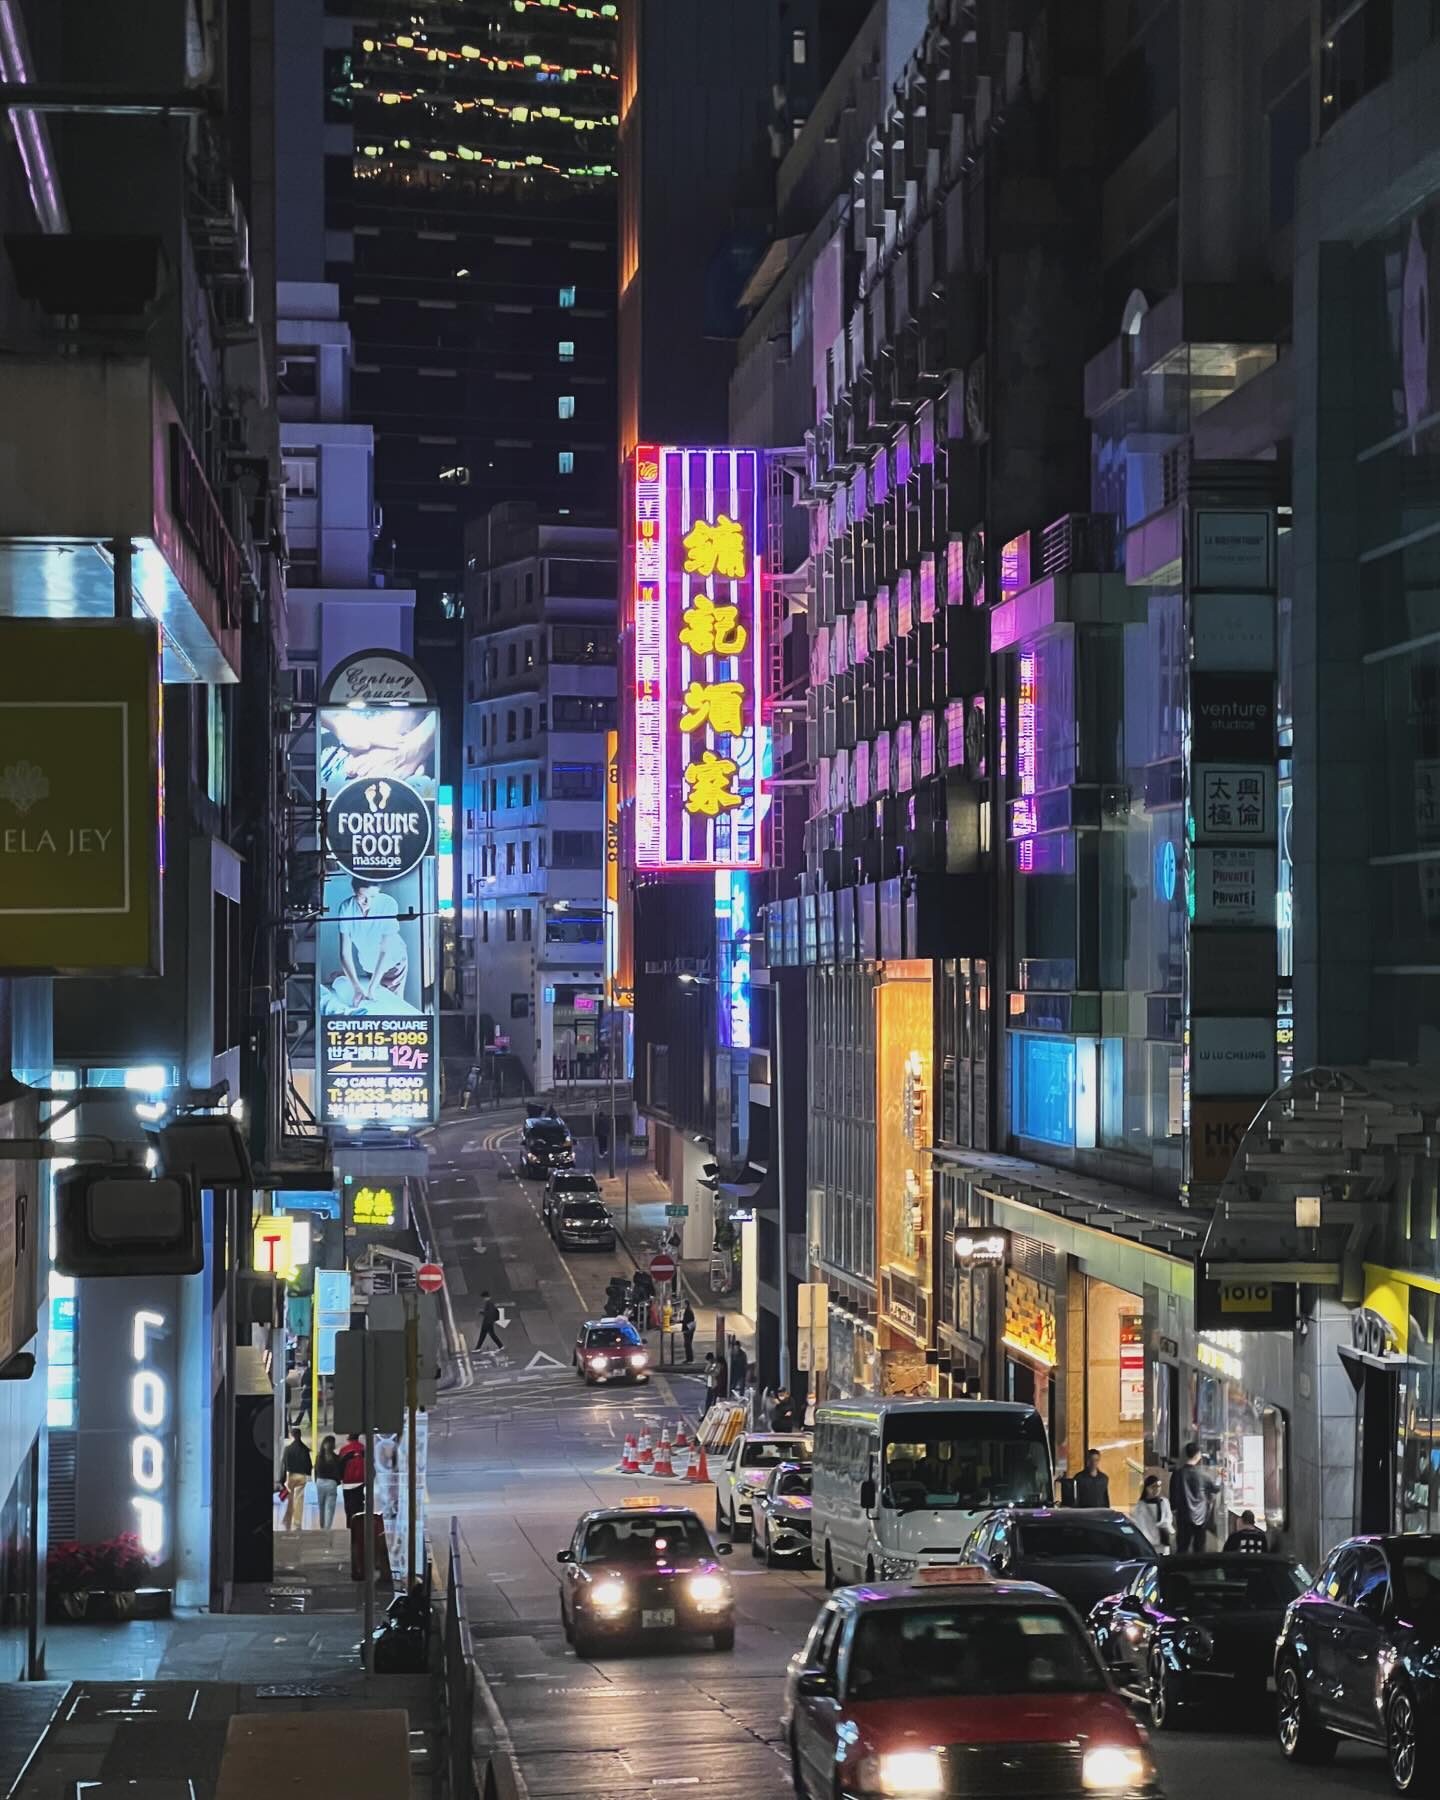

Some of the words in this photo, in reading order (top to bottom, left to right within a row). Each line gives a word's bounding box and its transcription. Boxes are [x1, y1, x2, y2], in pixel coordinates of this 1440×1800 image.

[346, 667, 414, 689] Century
[346, 684, 411, 699] Square
[1200, 701, 1267, 717] venture
[338, 812, 420, 835] FORTUNE
[4, 828, 57, 853] ELA
[66, 828, 113, 857] JEY
[352, 834, 403, 856] FOOT
[352, 855, 401, 868] massage
[327, 1020, 381, 1031] CENTURY
[381, 1020, 428, 1031] SQUARE
[344, 1031, 428, 1046] 2115-1999
[389, 1045, 429, 1070] 12/F
